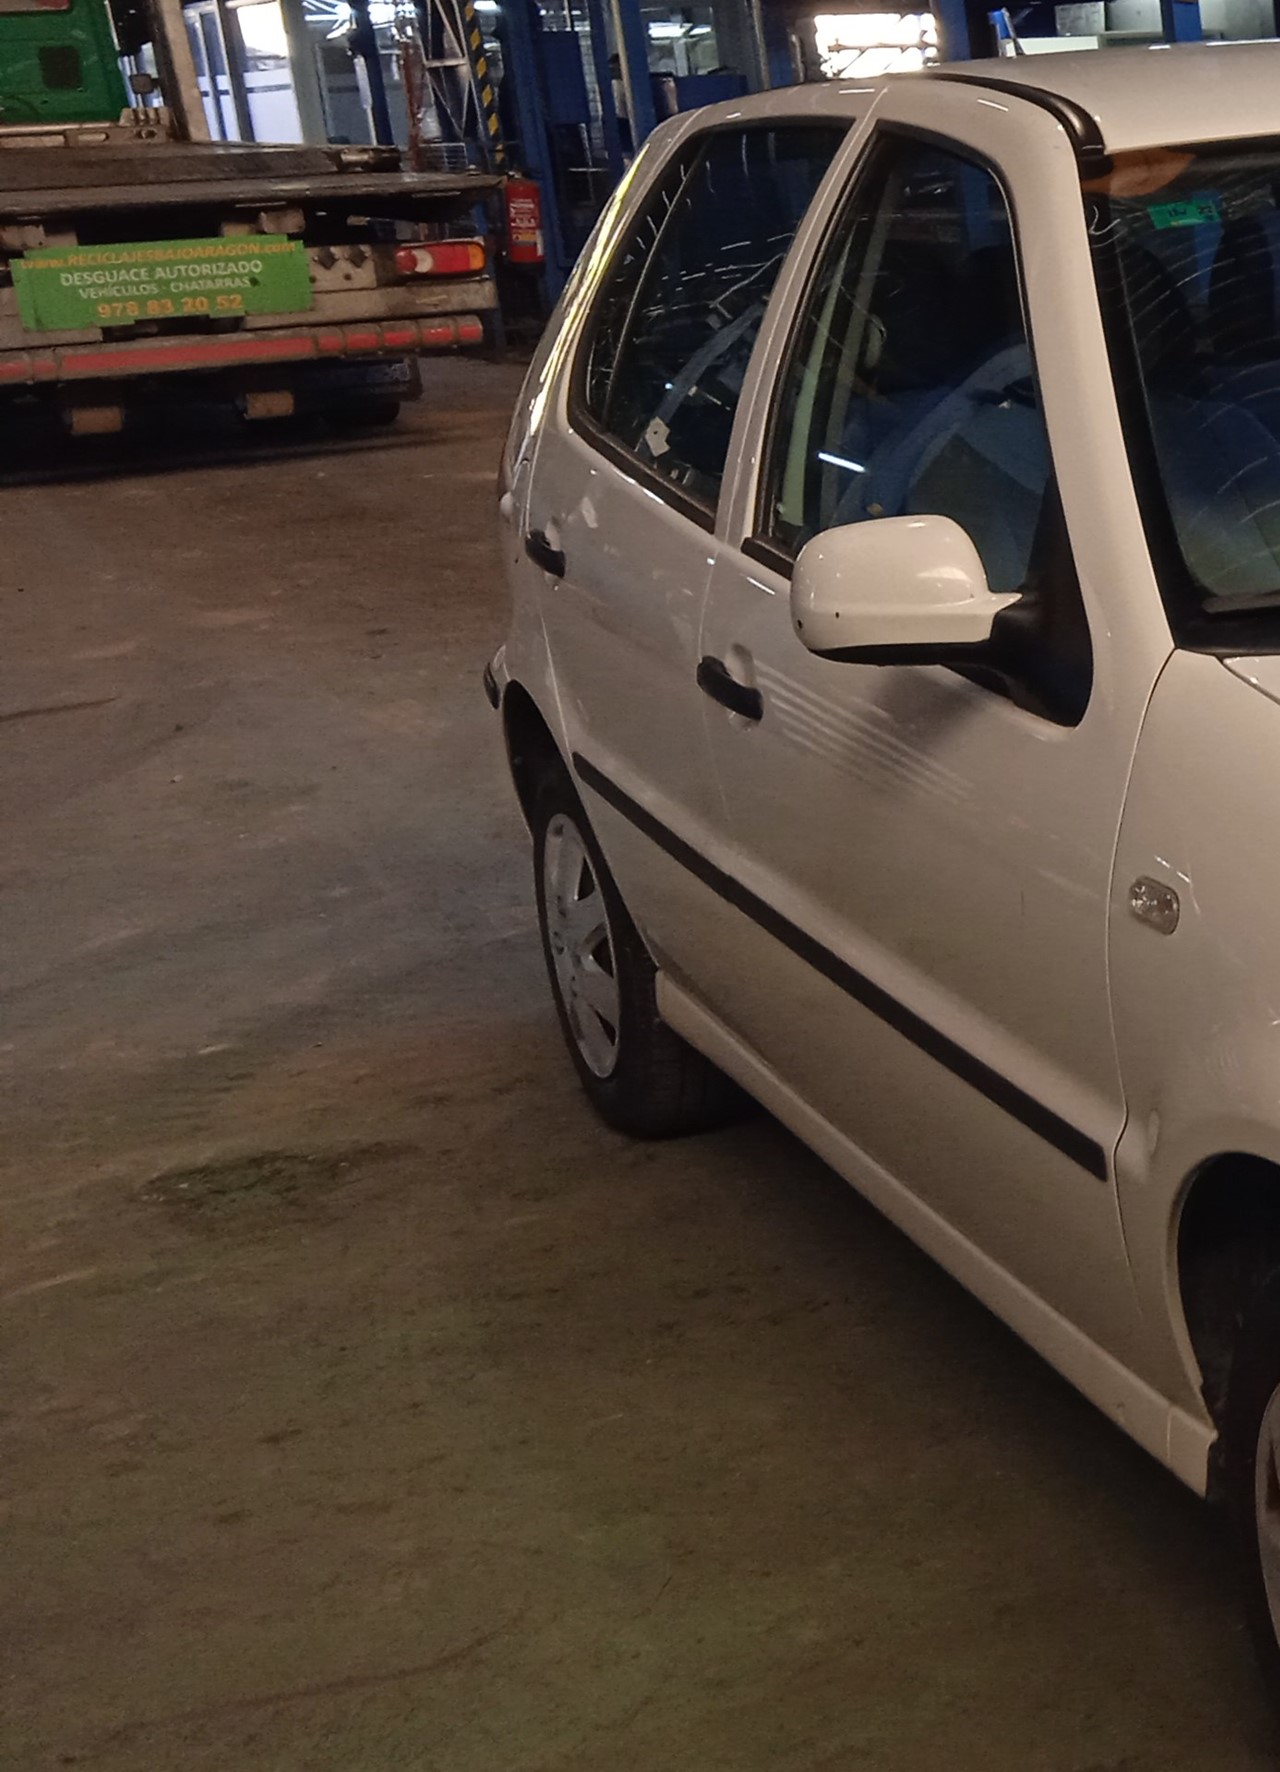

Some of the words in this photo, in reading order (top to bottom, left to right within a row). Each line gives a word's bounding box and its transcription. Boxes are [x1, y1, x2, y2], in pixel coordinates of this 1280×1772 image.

[60, 267, 149, 286] DESGUACE
[154, 260, 263, 279] AUTORIZADO
[170, 276, 251, 293] CHATARRAS
[97, 301, 139, 318] 978
[147, 298, 174, 315] 83
[181, 296, 209, 313] 20
[217, 294, 243, 310] 52
